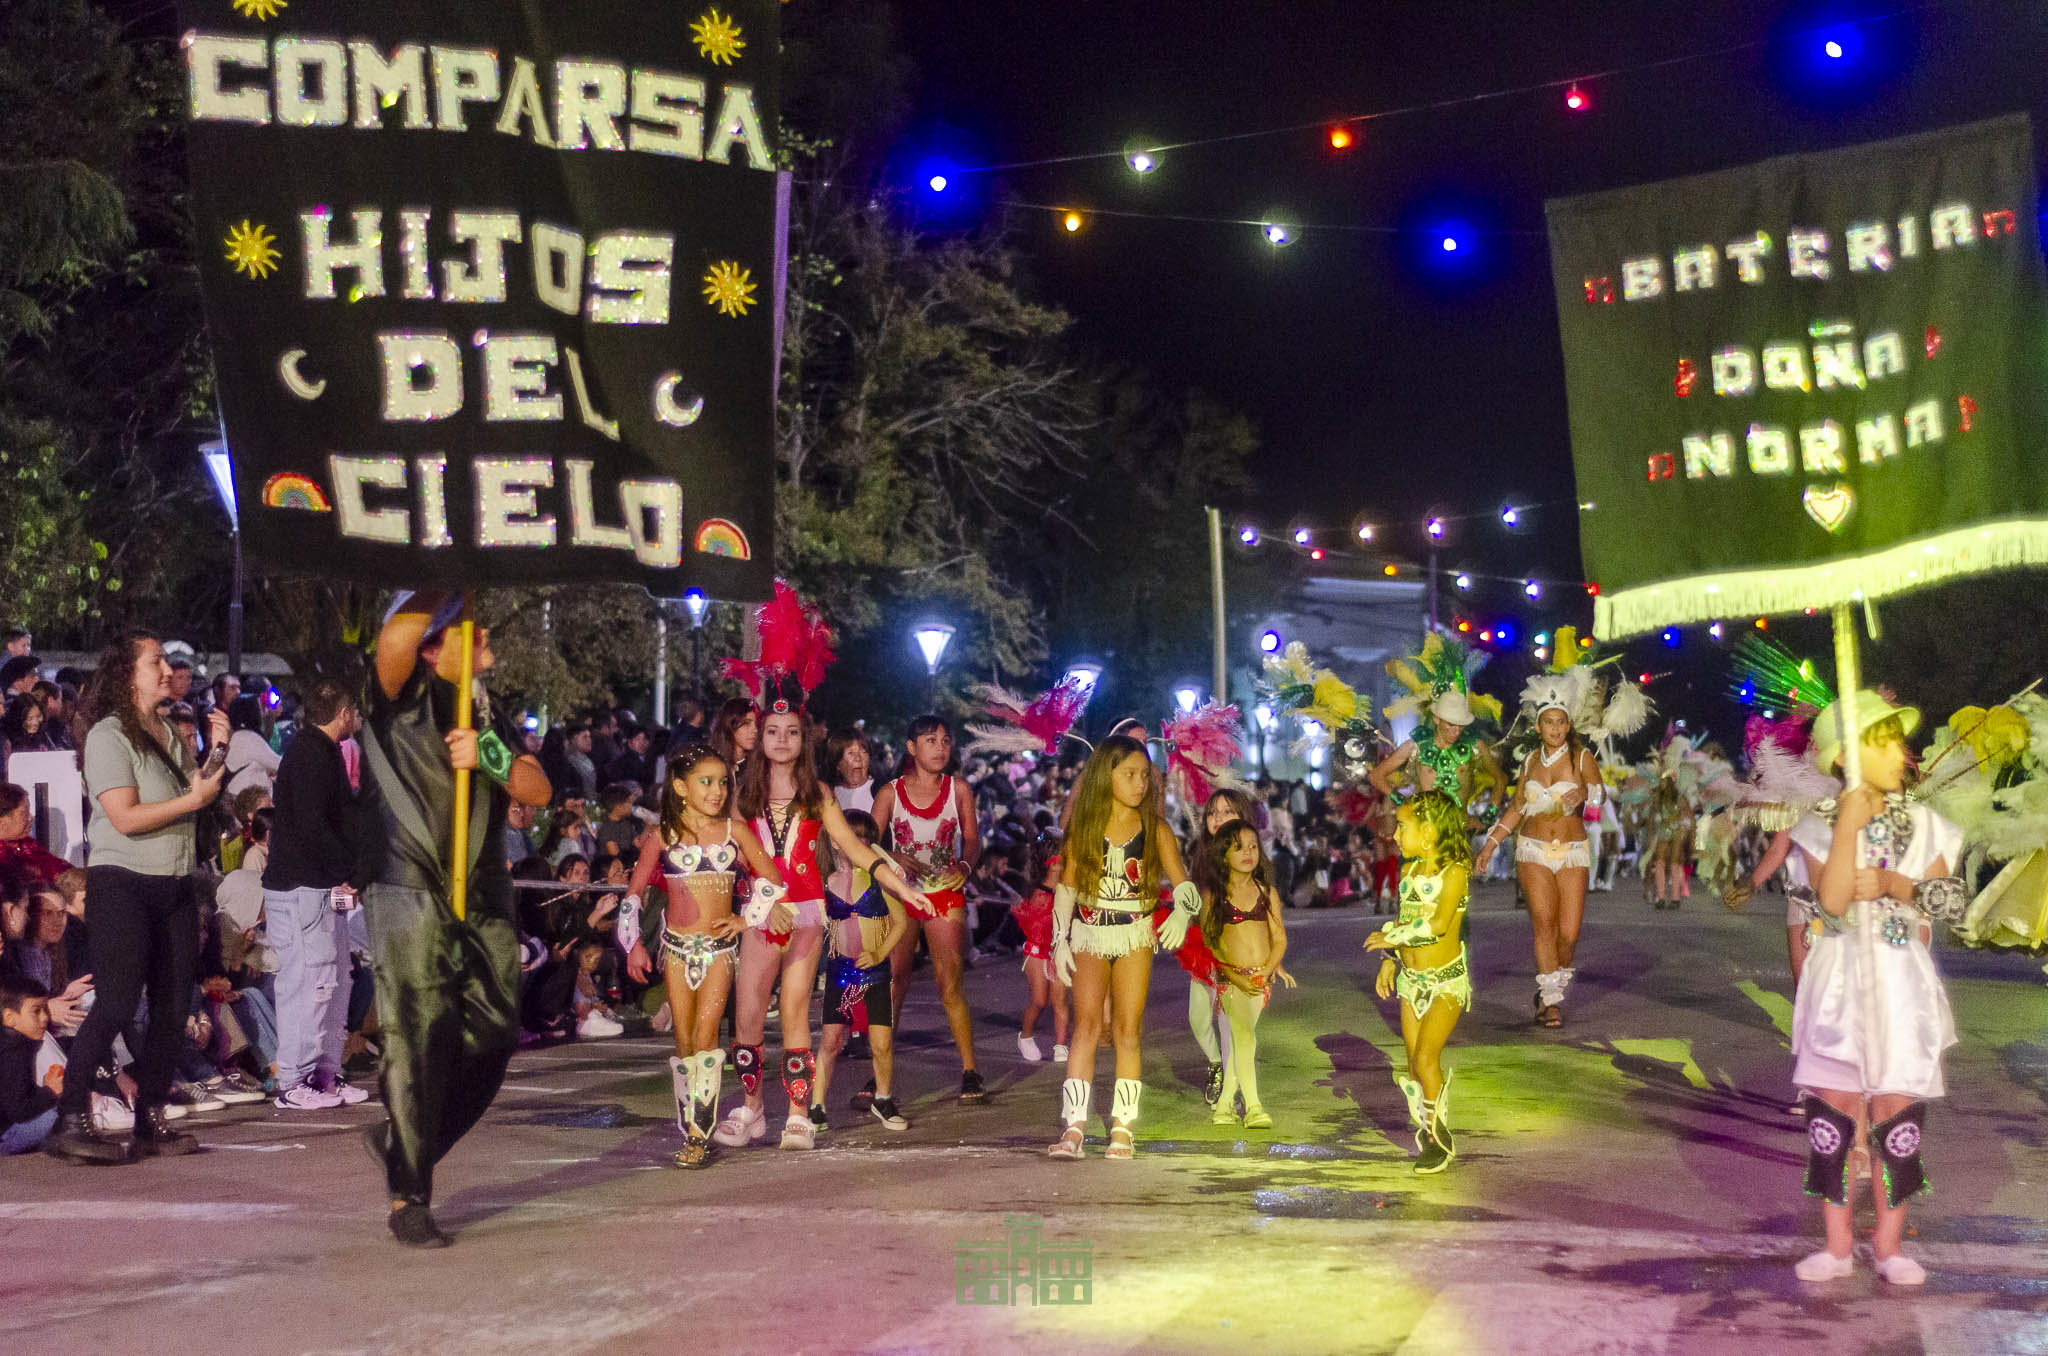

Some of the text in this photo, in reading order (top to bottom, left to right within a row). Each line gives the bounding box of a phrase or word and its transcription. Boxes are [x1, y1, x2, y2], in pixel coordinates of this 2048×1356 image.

[185, 33, 776, 171] COMPARSA
[299, 208, 675, 324] HIJOS
[1621, 203, 1974, 301] BATERIA
[379, 331, 620, 441] DEL
[1711, 322, 1905, 396] DOÑA
[1682, 400, 1942, 479] NORMA
[330, 453, 683, 568] CIELO
